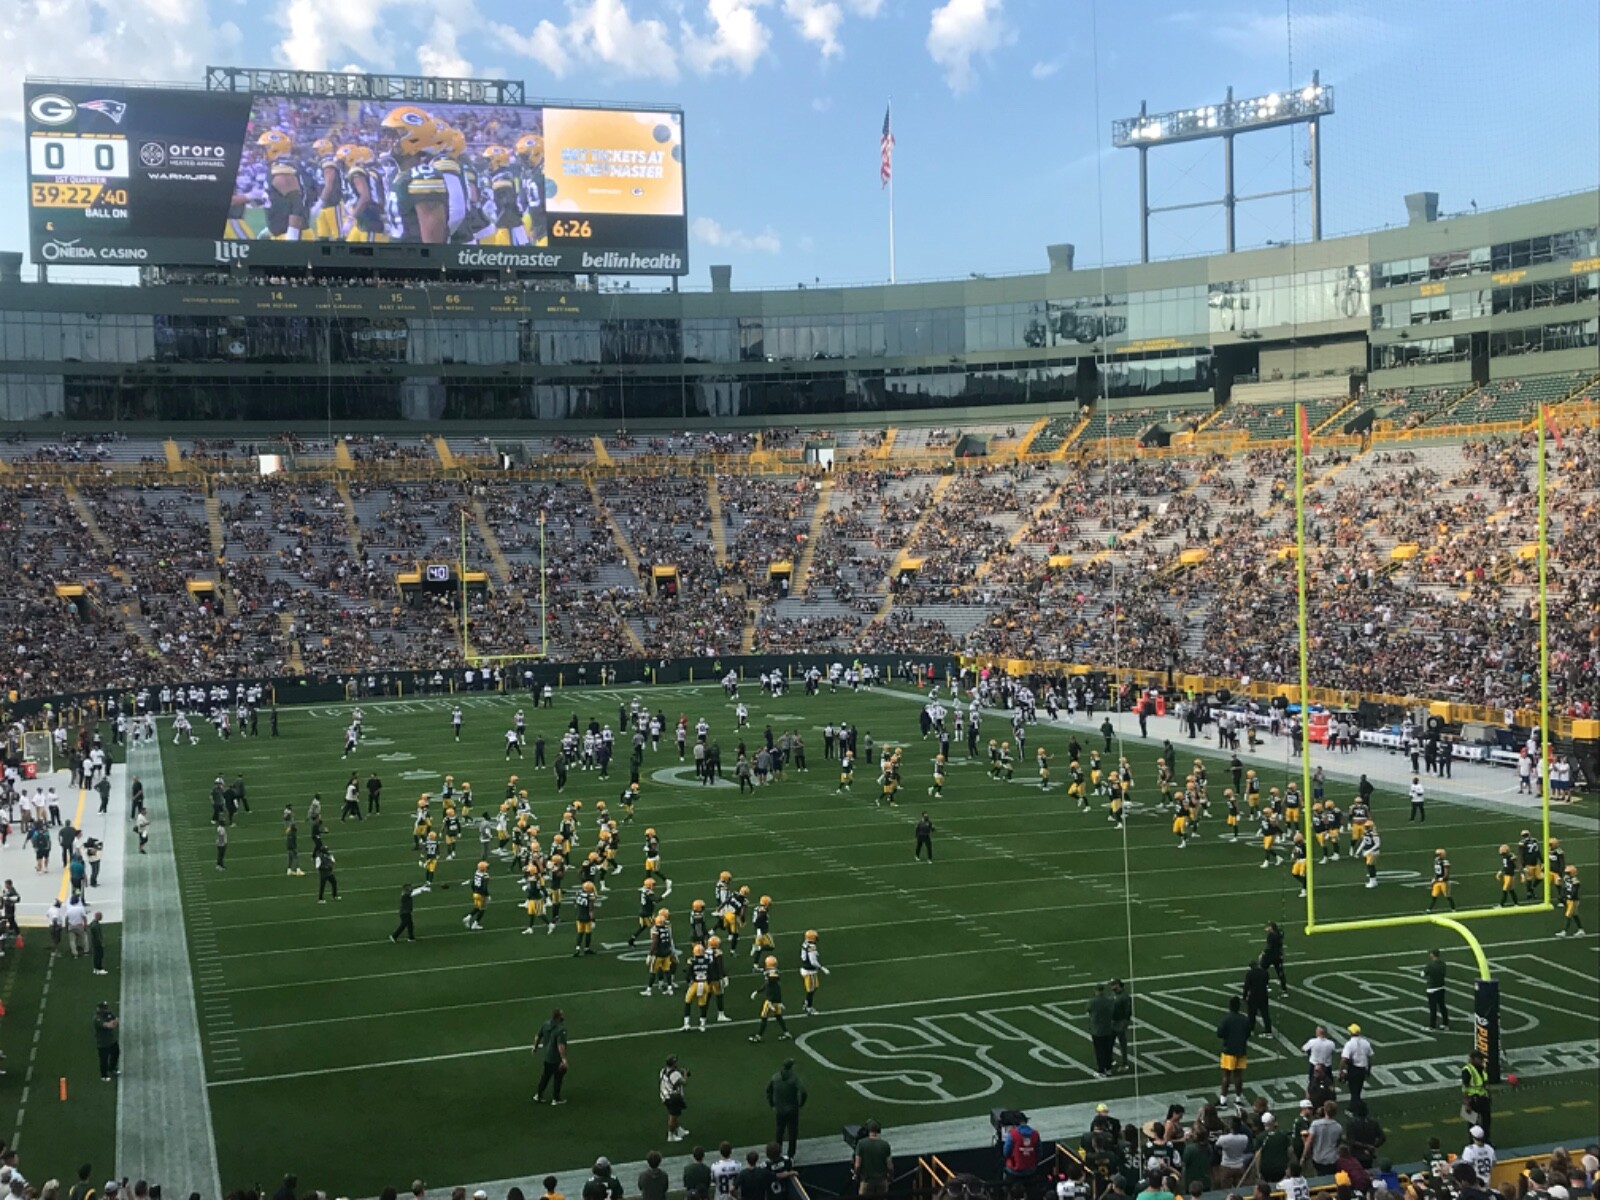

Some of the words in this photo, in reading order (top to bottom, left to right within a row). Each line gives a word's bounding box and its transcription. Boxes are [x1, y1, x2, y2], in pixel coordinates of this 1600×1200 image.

[250, 71, 391, 97] LAMBEAU
[403, 78, 487, 100] FIELD
[45, 142, 64, 169] 0
[95, 144, 114, 171] 0
[169, 145, 225, 157] ororo
[647, 151, 664, 164] AT
[70, 176, 107, 184] QUARTER
[148, 173, 217, 181] WARMUPS
[34, 186, 92, 204] 39:22
[85, 208, 110, 218] BALL
[112, 209, 128, 218] ON
[552, 220, 592, 238] 6:26
[100, 249, 148, 259] CASINO
[214, 241, 249, 261] Lite
[458, 250, 561, 267] ticketmaster
